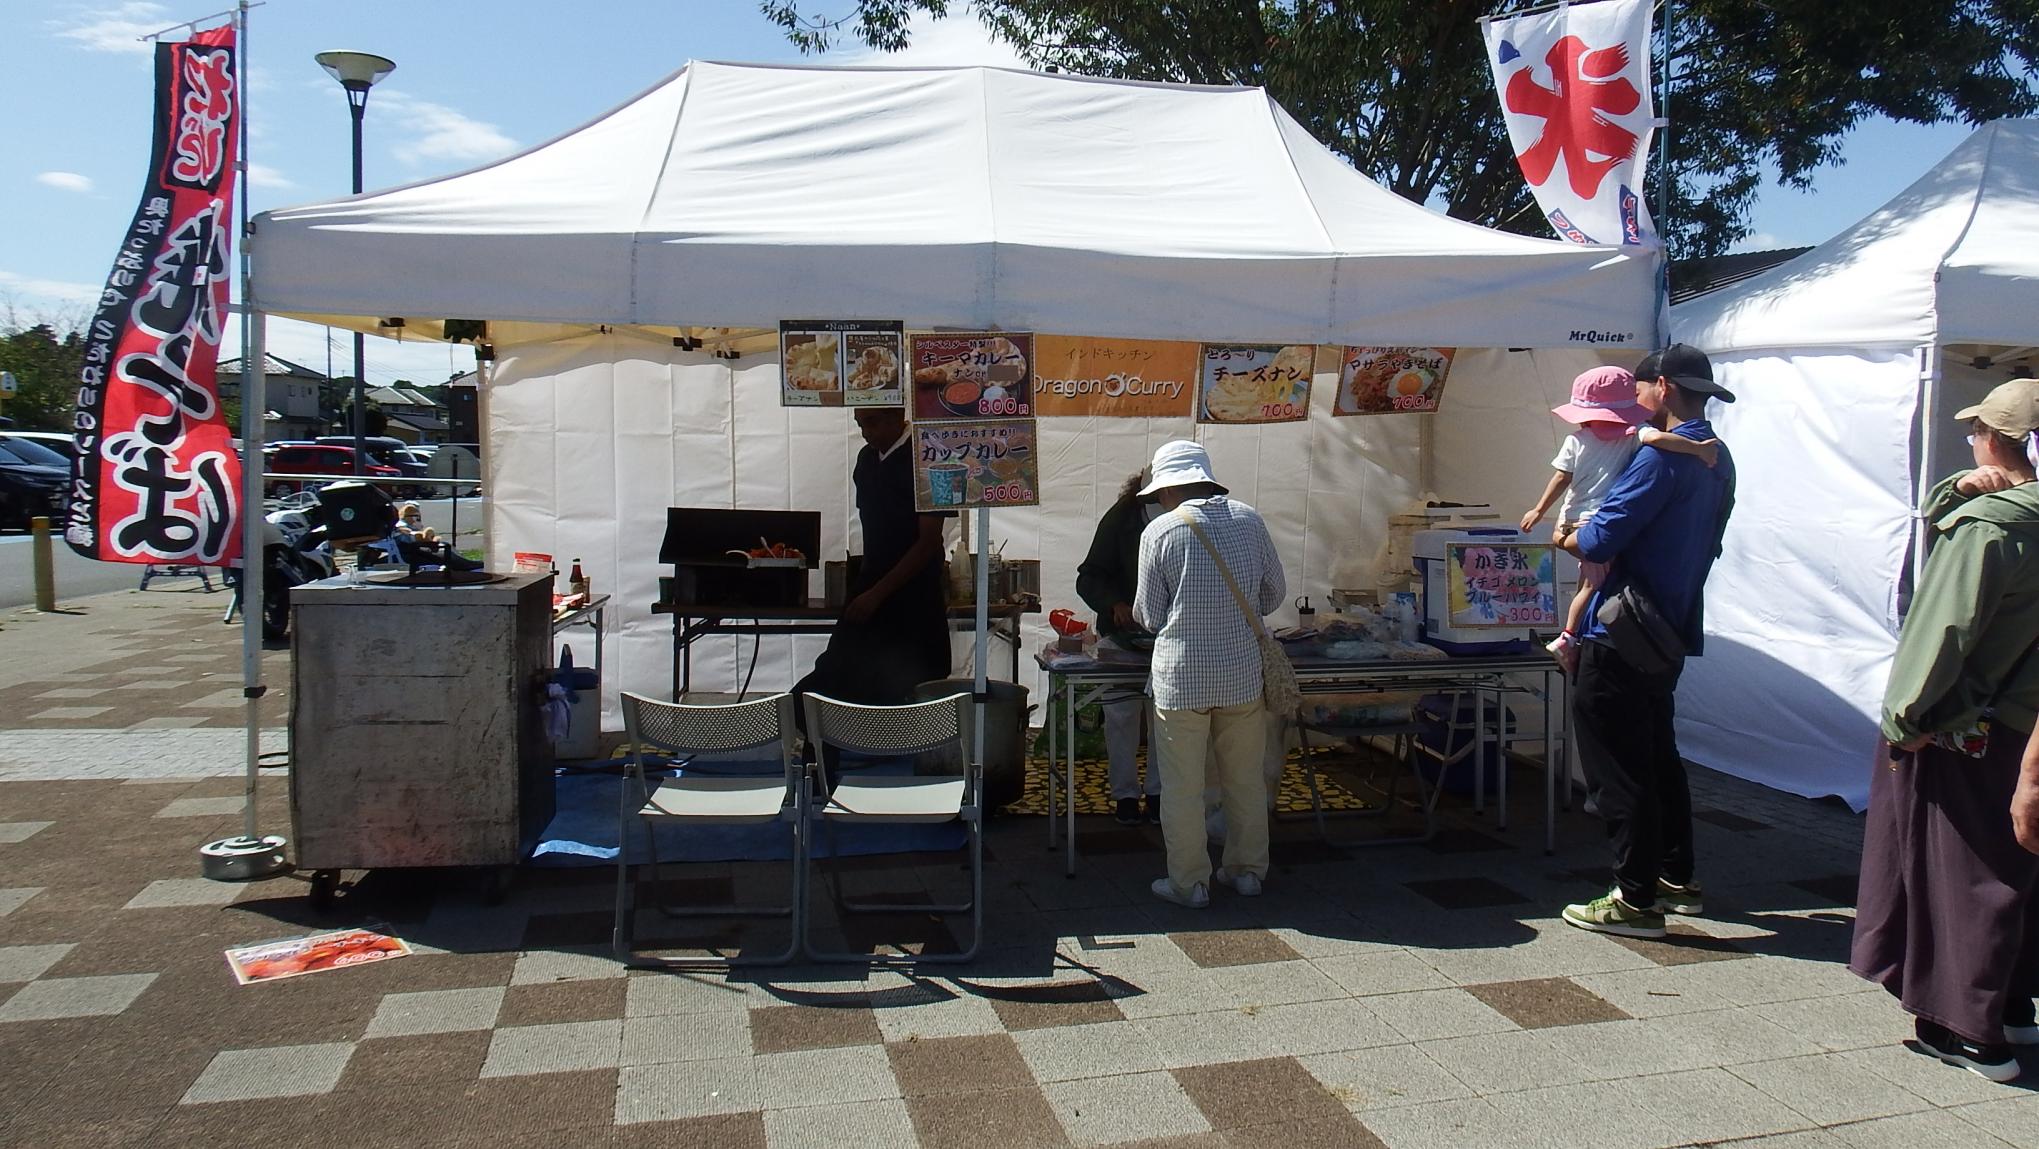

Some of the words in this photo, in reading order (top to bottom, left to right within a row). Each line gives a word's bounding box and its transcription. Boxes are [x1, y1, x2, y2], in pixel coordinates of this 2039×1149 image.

[922, 351, 1020, 367] キーマカレー
[1065, 347, 1153, 361] インドキッチン
[1349, 357, 1444, 371] マサラやきそば
[1212, 364, 1303, 382] チーズナン
[1126, 374, 1185, 398] Curry
[978, 397, 1029, 415] 800円
[1392, 394, 1435, 409] 700円
[1261, 403, 1305, 417] 700円
[922, 442, 1028, 462] カップカレー
[983, 483, 1034, 502] 500円
[1475, 552, 1529, 570] かき氷
[1465, 576, 1500, 589] イチゴ
[1507, 576, 1539, 588] メロン
[1465, 591, 1541, 604] ブルーハワイ
[1510, 607, 1553, 622] 300円
